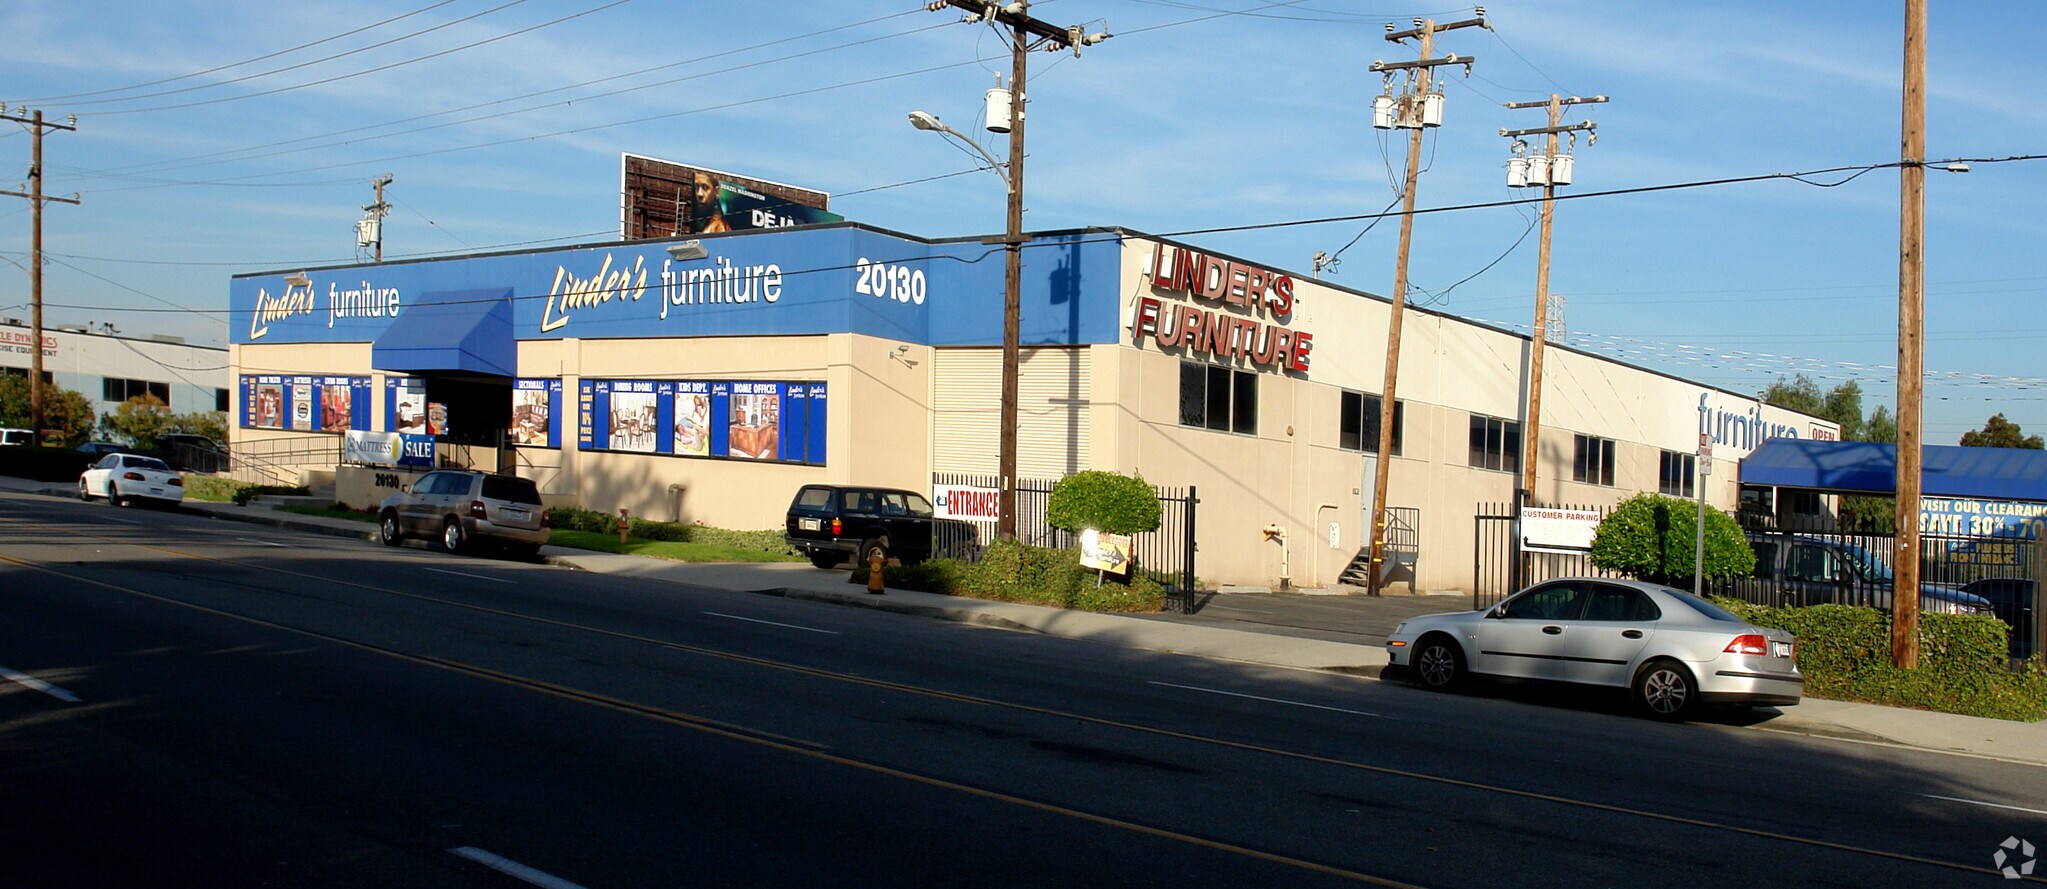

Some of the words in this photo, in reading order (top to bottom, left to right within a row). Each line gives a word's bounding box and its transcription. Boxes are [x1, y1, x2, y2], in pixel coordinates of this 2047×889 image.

[855, 257, 927, 305] 20130
[1151, 242, 1294, 316] LINDER'S
[541, 252, 648, 333] Linder's
[659, 258, 783, 320] furniture
[250, 279, 315, 340] Linder's
[328, 281, 400, 329] furniture
[15, 332, 58, 347] DYNICS
[1132, 296, 1313, 372] FURNITURE
[16, 346, 57, 357] EQUIENT
[733, 383, 752, 394] HOME
[752, 384, 777, 394] OFFICES
[356, 440, 392, 454] MATTRESS
[404, 441, 432, 457] SALE
[375, 473, 399, 489] 20130
[947, 489, 999, 518] ENTRANCE
[1919, 500, 1951, 512] VISIT
[1953, 501, 1981, 514] OUR
[1522, 510, 1563, 520] CUSTOMER
[1565, 513, 1599, 522] PARKING
[1918, 512, 1963, 535] SAVE
[1970, 514, 2005, 535] 30%
